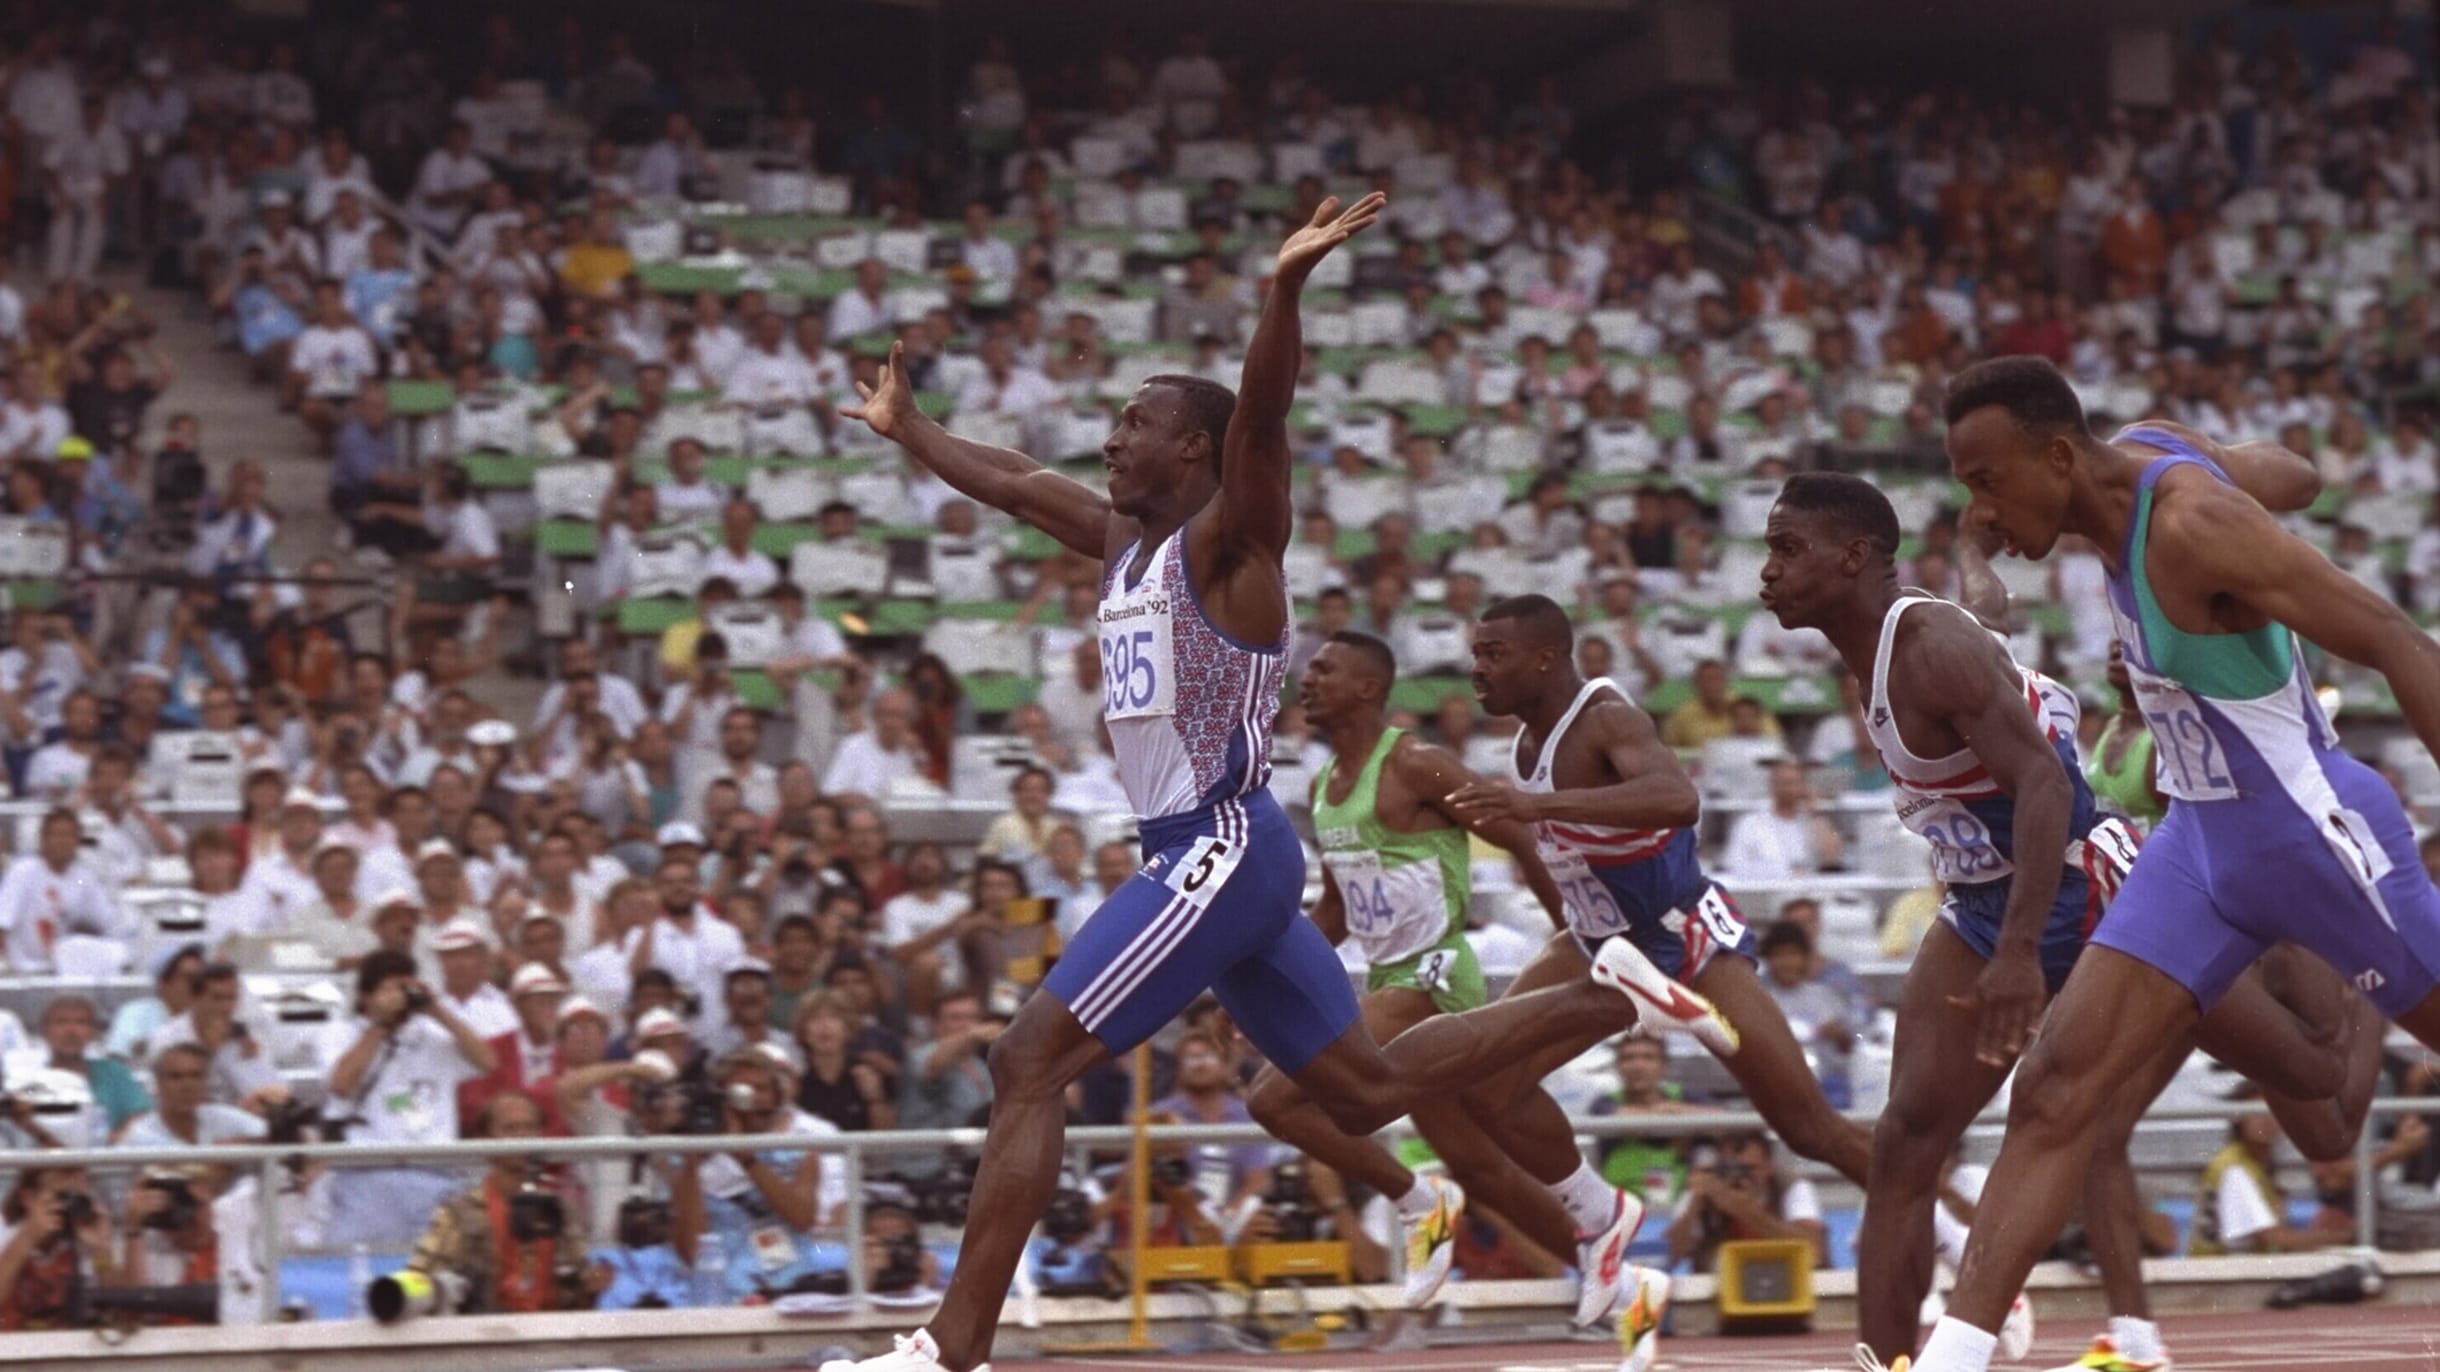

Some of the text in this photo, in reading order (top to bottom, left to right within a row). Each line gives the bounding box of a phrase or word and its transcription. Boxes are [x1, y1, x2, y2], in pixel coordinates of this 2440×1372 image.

[1183, 840, 1228, 893] 5
[1705, 899, 1735, 936] 6
[1426, 952, 1443, 987] 8
